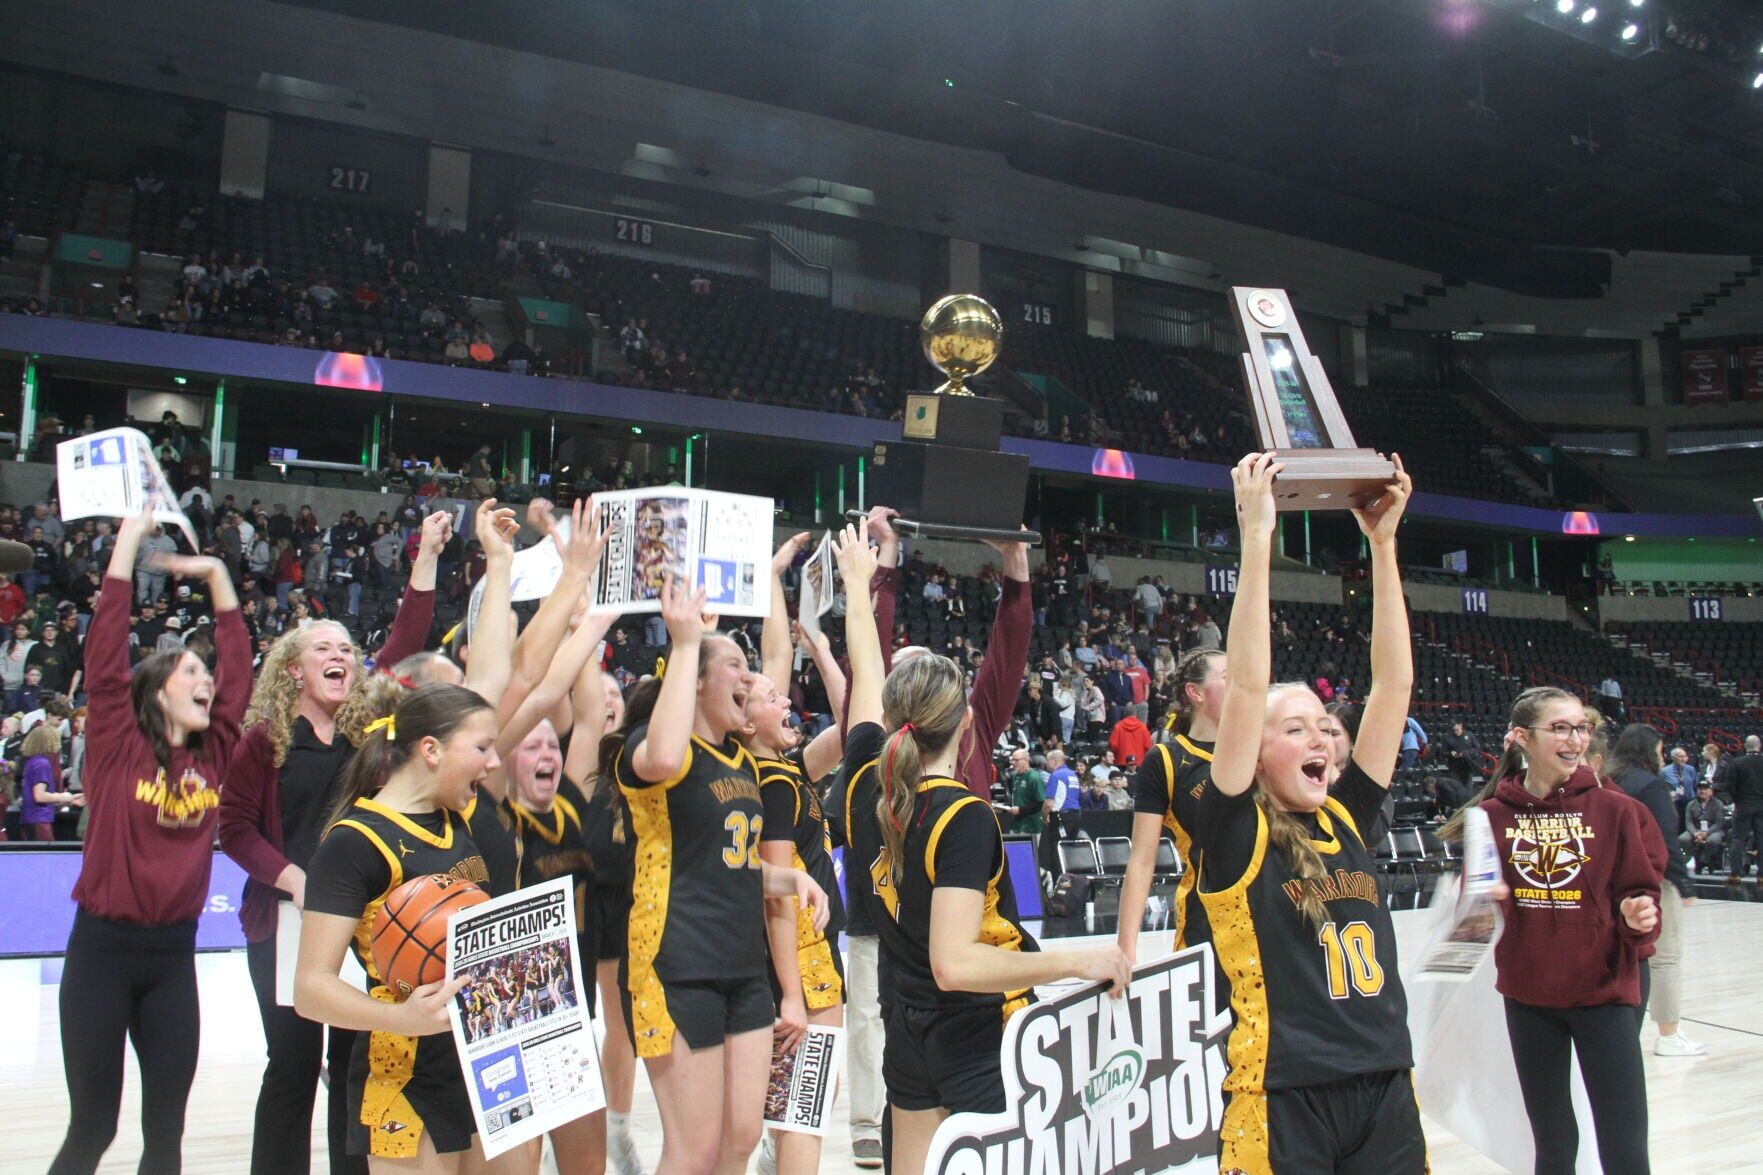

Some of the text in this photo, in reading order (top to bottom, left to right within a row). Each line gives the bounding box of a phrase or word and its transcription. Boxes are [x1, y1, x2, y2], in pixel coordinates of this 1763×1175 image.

[332, 168, 369, 191] 217
[617, 220, 652, 244] 216
[1024, 304, 1051, 325] 215
[1210, 569, 1237, 592] 115
[1465, 591, 1486, 612] 114
[1693, 600, 1720, 618] 113
[1505, 826, 1595, 840] BASKETBALL
[1517, 817, 1582, 829] WARRIOR
[723, 810, 763, 869] 32
[1514, 888, 1581, 900] STATE 2026
[454, 905, 566, 959] STATE CHAMPS!
[1319, 921, 1384, 999] 10
[805, 1032, 824, 1068] STATE
[1021, 960, 1202, 1131] STATE
[1092, 1063, 1133, 1099] WIAA
[794, 1070, 817, 1126] CHAMPS!
